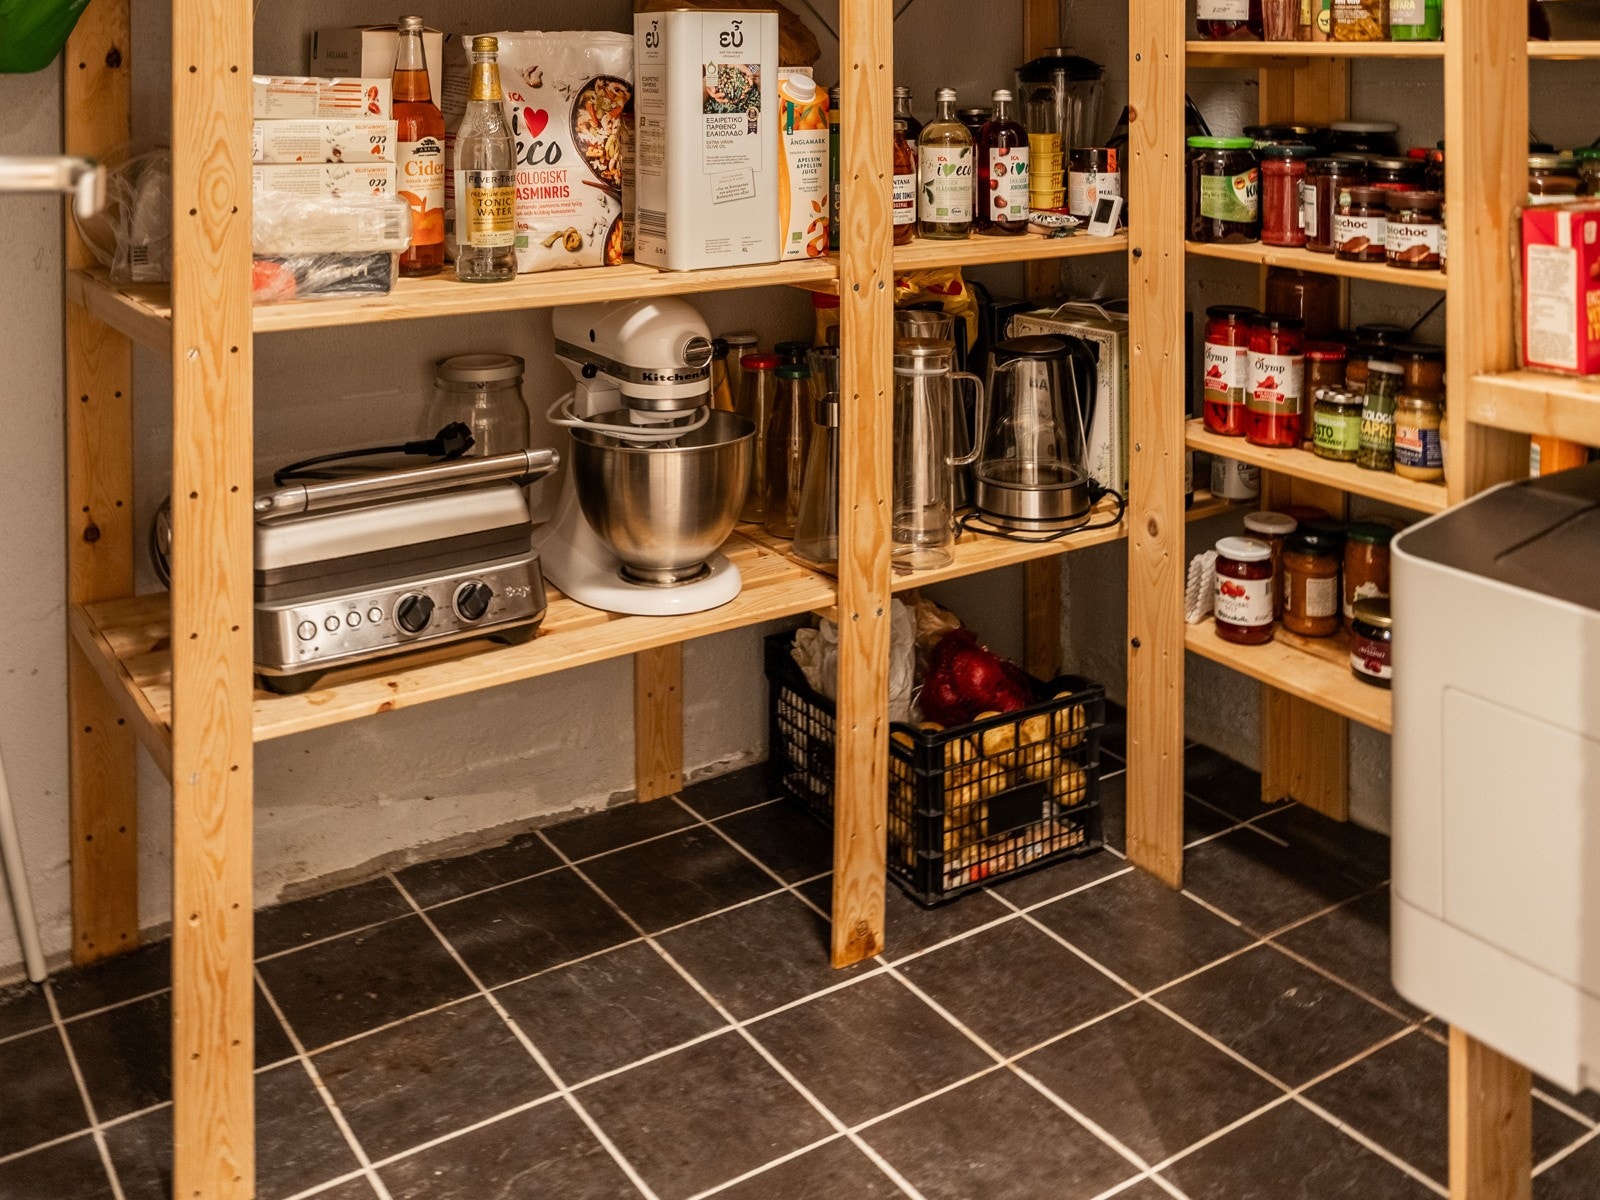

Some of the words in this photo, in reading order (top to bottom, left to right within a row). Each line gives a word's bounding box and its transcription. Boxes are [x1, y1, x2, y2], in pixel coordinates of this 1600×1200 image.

[404, 160, 444, 177] Cider
[516, 170, 568, 186] KOLOGISKT
[516, 185, 570, 201] ASMINRIS
[479, 197, 511, 207] TONIC
[476, 207, 512, 217] WATER
[1335, 218, 1368, 230] iochoc
[1387, 224, 1428, 238] biochoc
[642, 366, 710, 382] KitchenA
